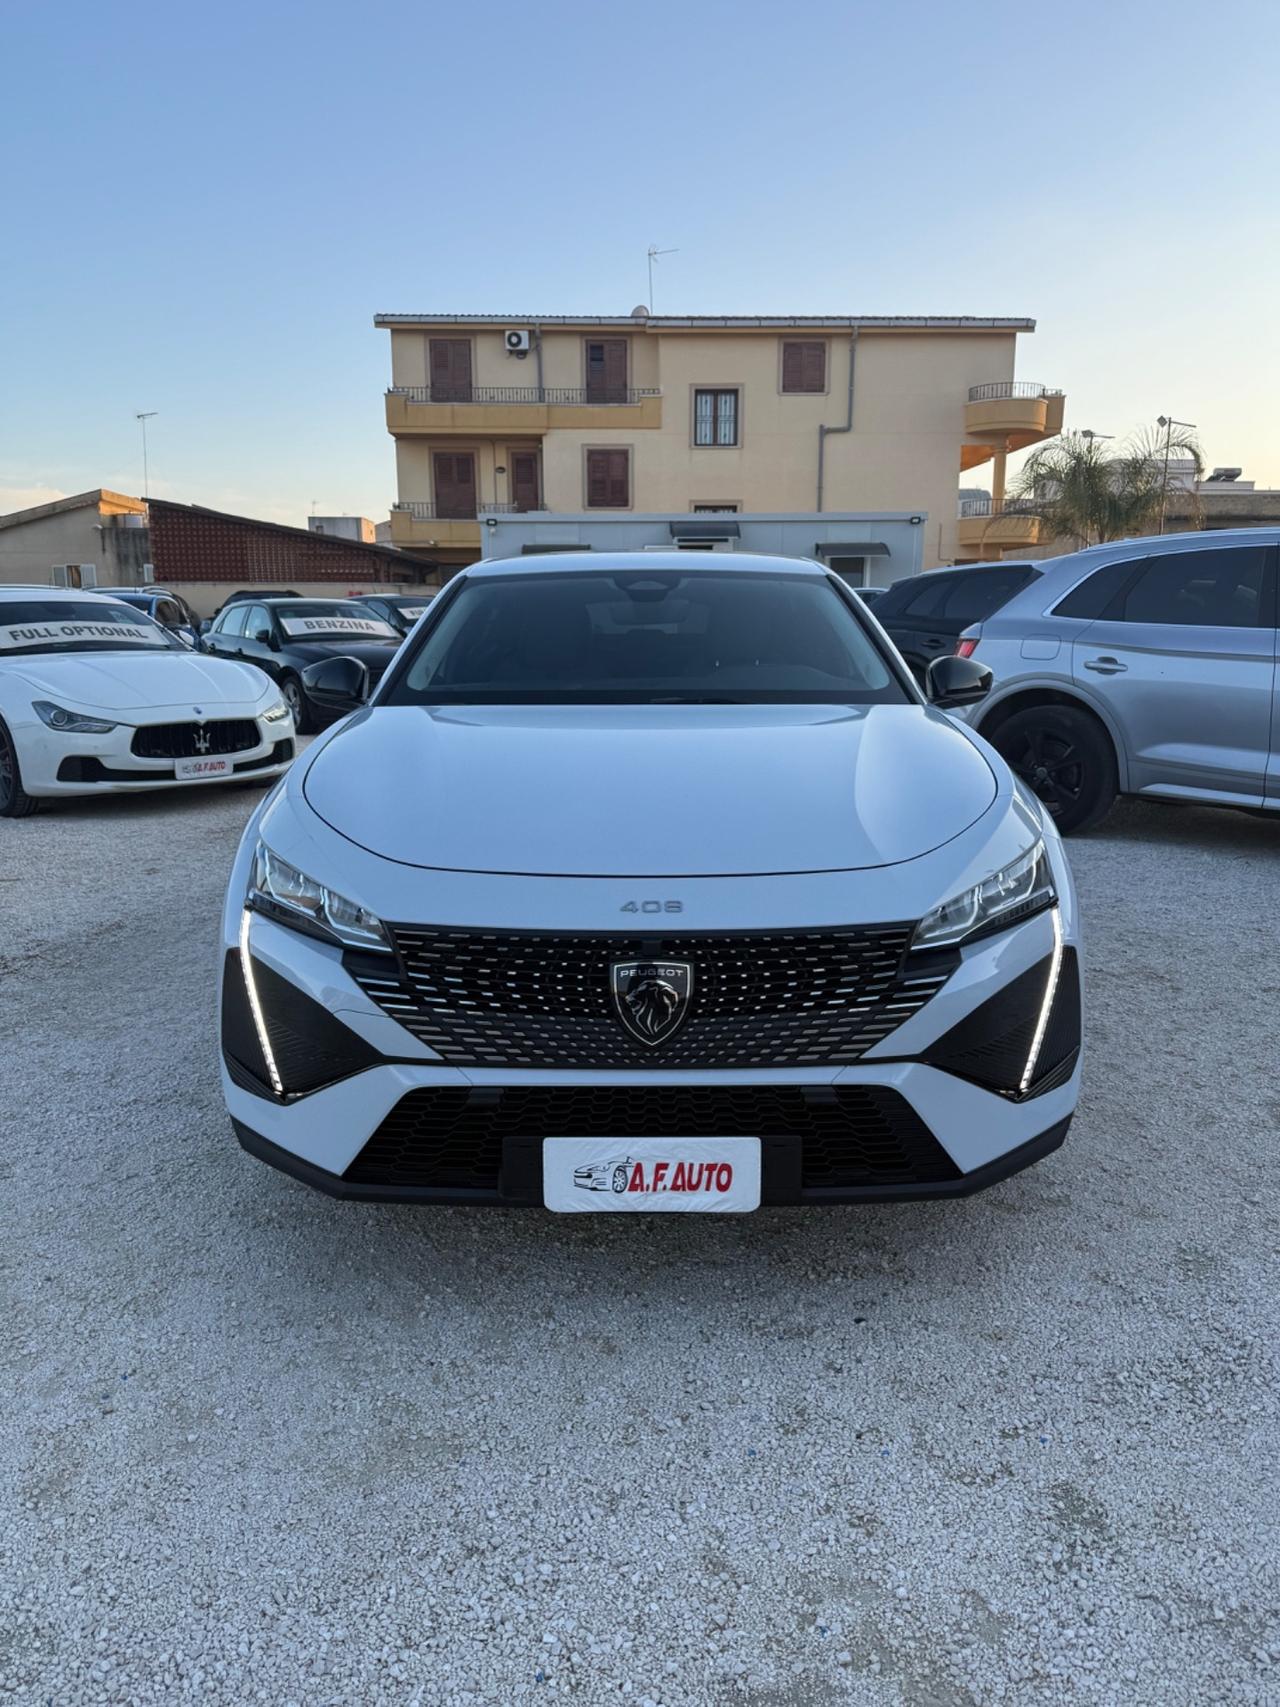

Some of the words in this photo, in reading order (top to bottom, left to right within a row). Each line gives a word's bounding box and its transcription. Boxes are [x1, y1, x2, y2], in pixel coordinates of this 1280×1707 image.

[303, 620, 376, 632] BENZINA
[9, 626, 59, 641] FULL
[60, 626, 149, 639] OPTIONAL
[620, 900, 683, 914] 408
[620, 968, 684, 977] PEUGEOT
